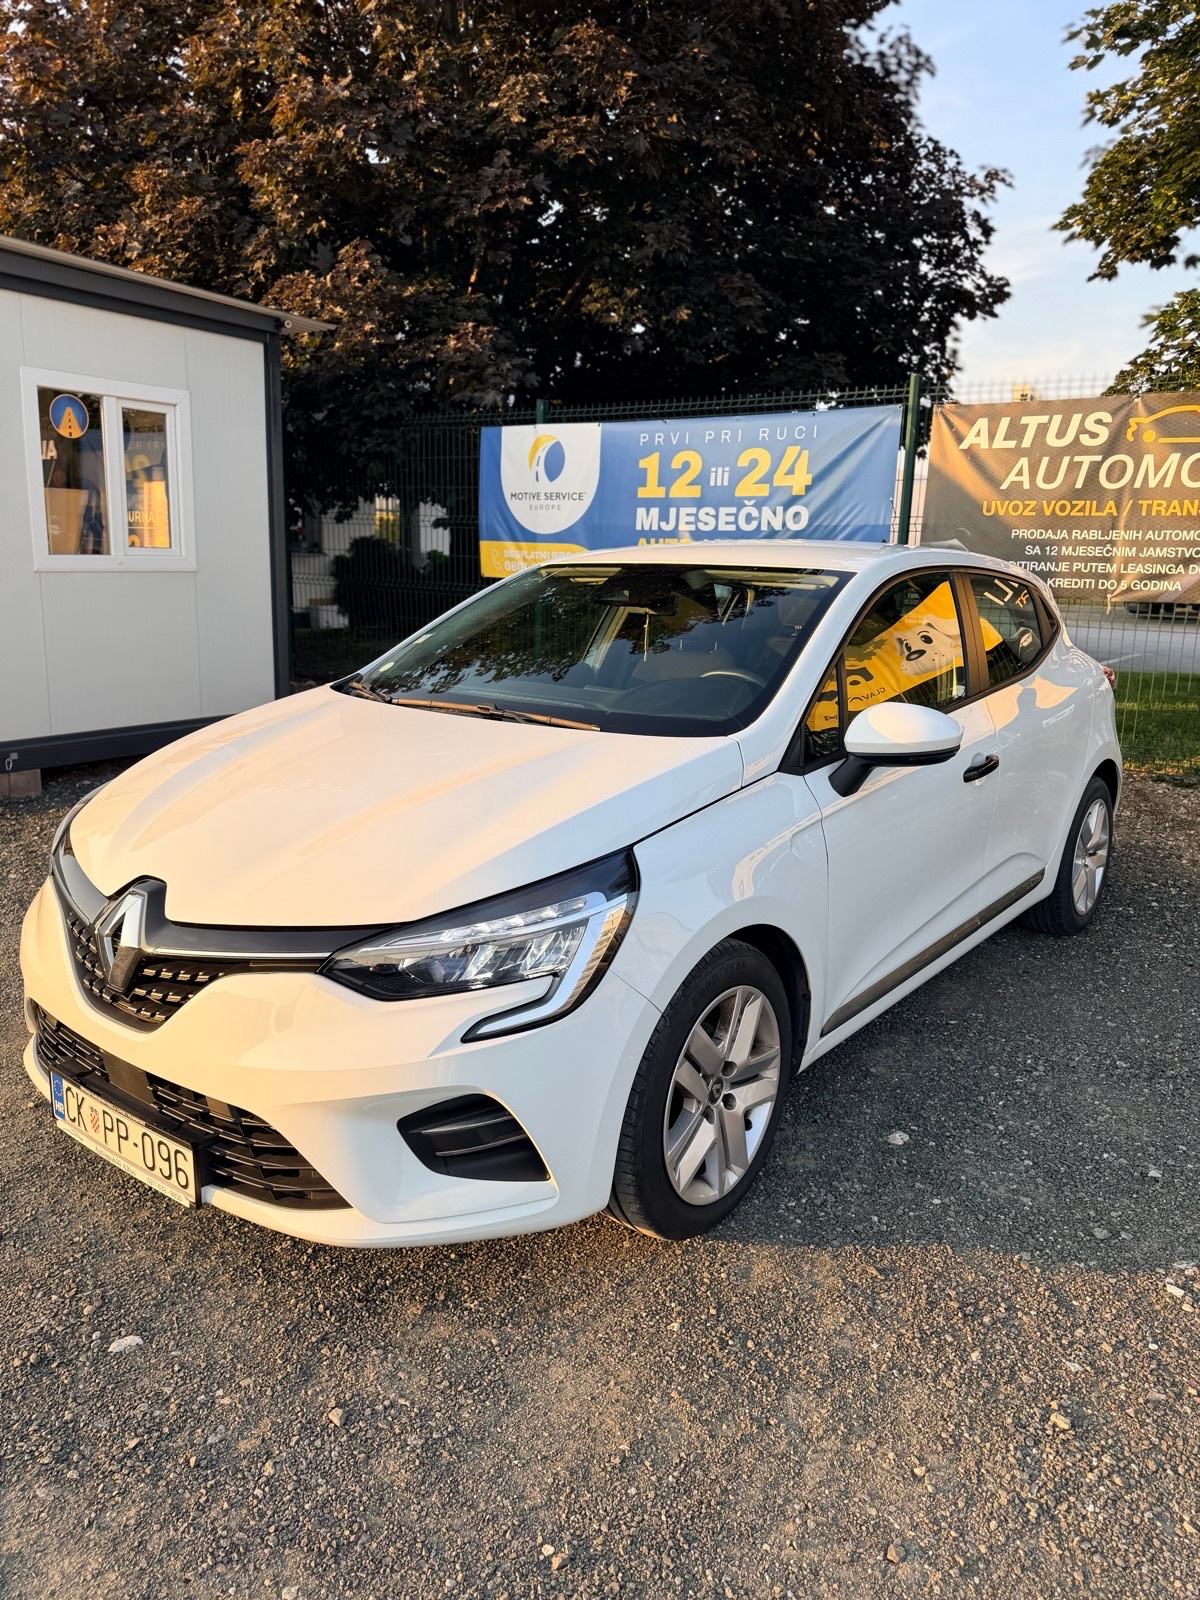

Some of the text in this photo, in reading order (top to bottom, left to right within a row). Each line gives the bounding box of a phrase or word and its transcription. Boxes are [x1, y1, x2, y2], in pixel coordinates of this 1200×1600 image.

[639, 425, 817, 446] PRVI PRI RUCI
[959, 412, 1113, 449] ALTUS
[637, 445, 813, 498] 12 ili 24
[1000, 453, 1200, 490] AUTOMO
[510, 492, 585, 501] MOTIVE SERVICE
[635, 500, 809, 532] MJESEČNO
[982, 500, 1036, 516] UVOZ
[1041, 500, 1118, 516] VOZILA
[1139, 500, 1200, 516] TRAN
[1011, 529, 1068, 540] PRODAJA
[1072, 529, 1143, 541] RABLJENIH
[1024, 544, 1200, 558] SA 12 MJESEČNIM JAMSTVO
[1072, 561, 1117, 573] PUTEM
[1120, 562, 1185, 575] LEASINGA
[1047, 577, 1182, 591] KREDITI DO 5 GODINA
[65, 1086, 88, 1132] CK
[102, 1109, 189, 1190] PP-096
